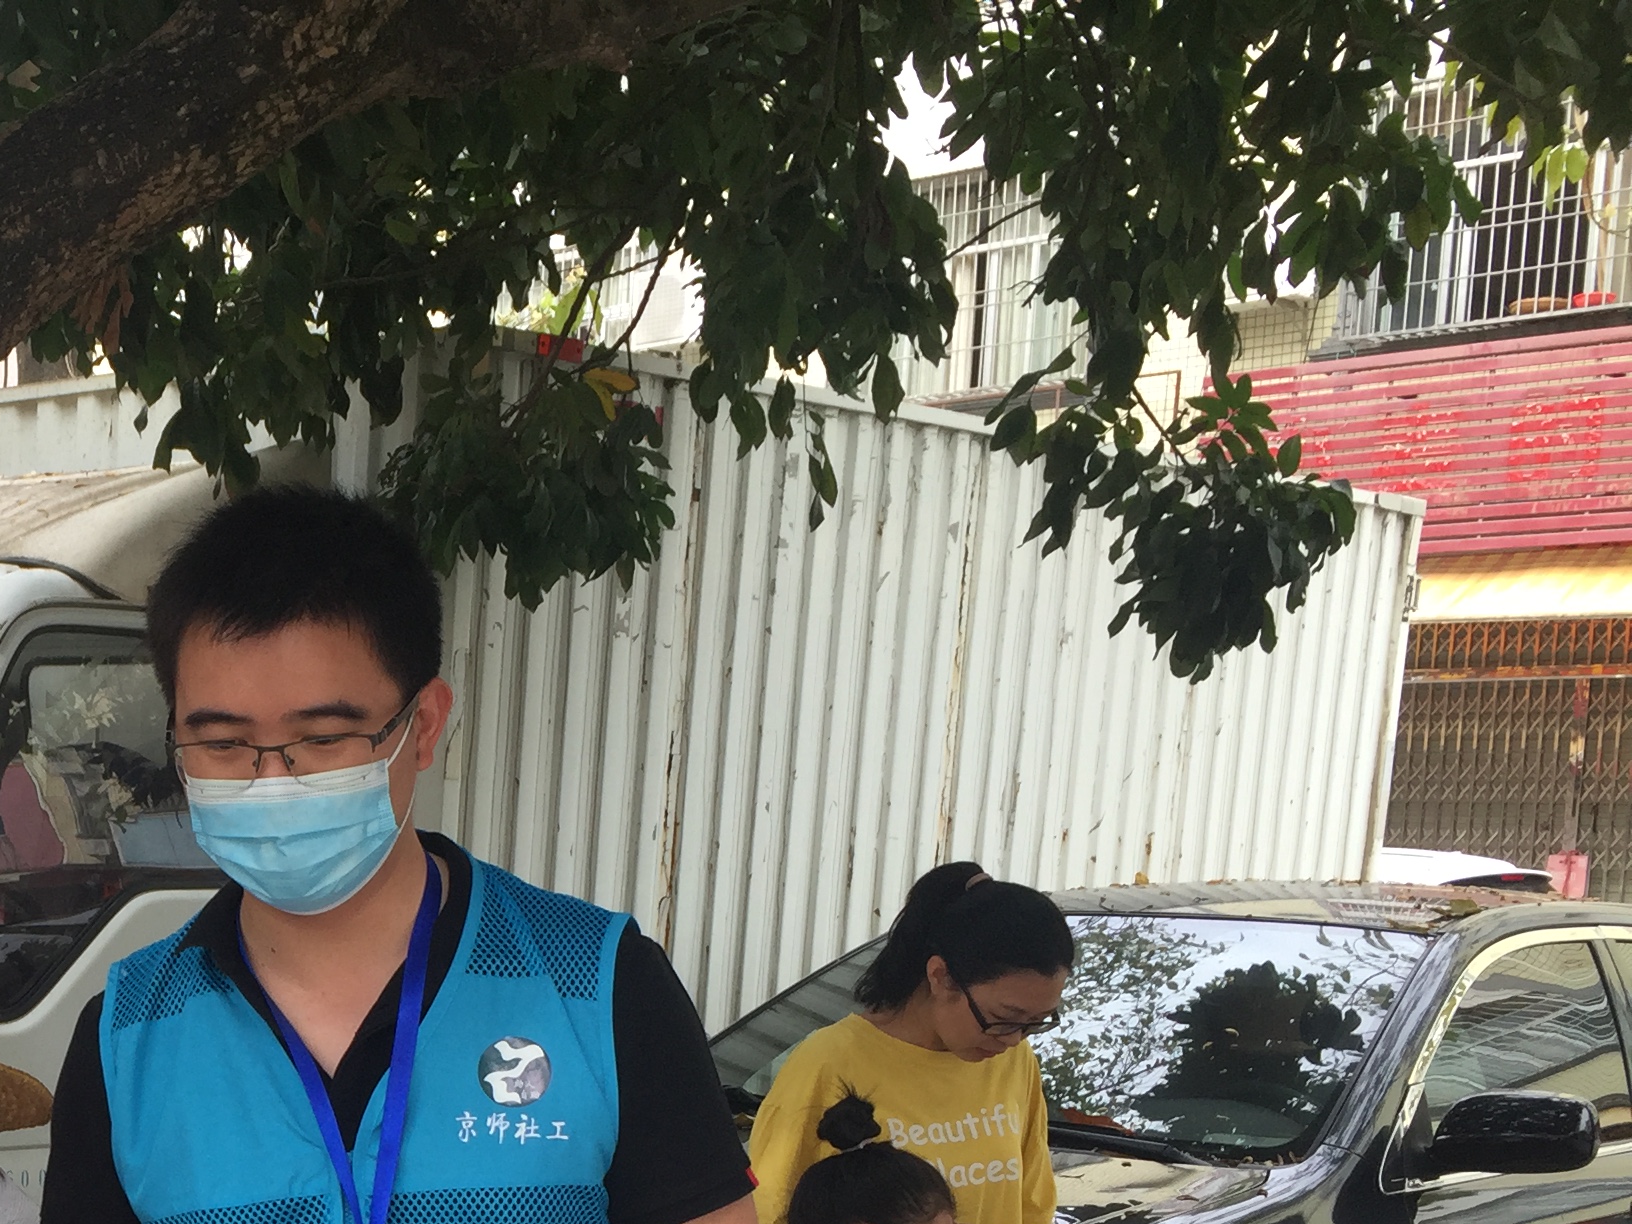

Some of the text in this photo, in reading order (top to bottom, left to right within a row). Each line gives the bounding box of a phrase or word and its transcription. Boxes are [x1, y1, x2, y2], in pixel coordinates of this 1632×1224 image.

[455, 1111, 569, 1145] 京师社工
[886, 1103, 1020, 1149] Beautifu
[934, 1157, 1018, 1188] laces
